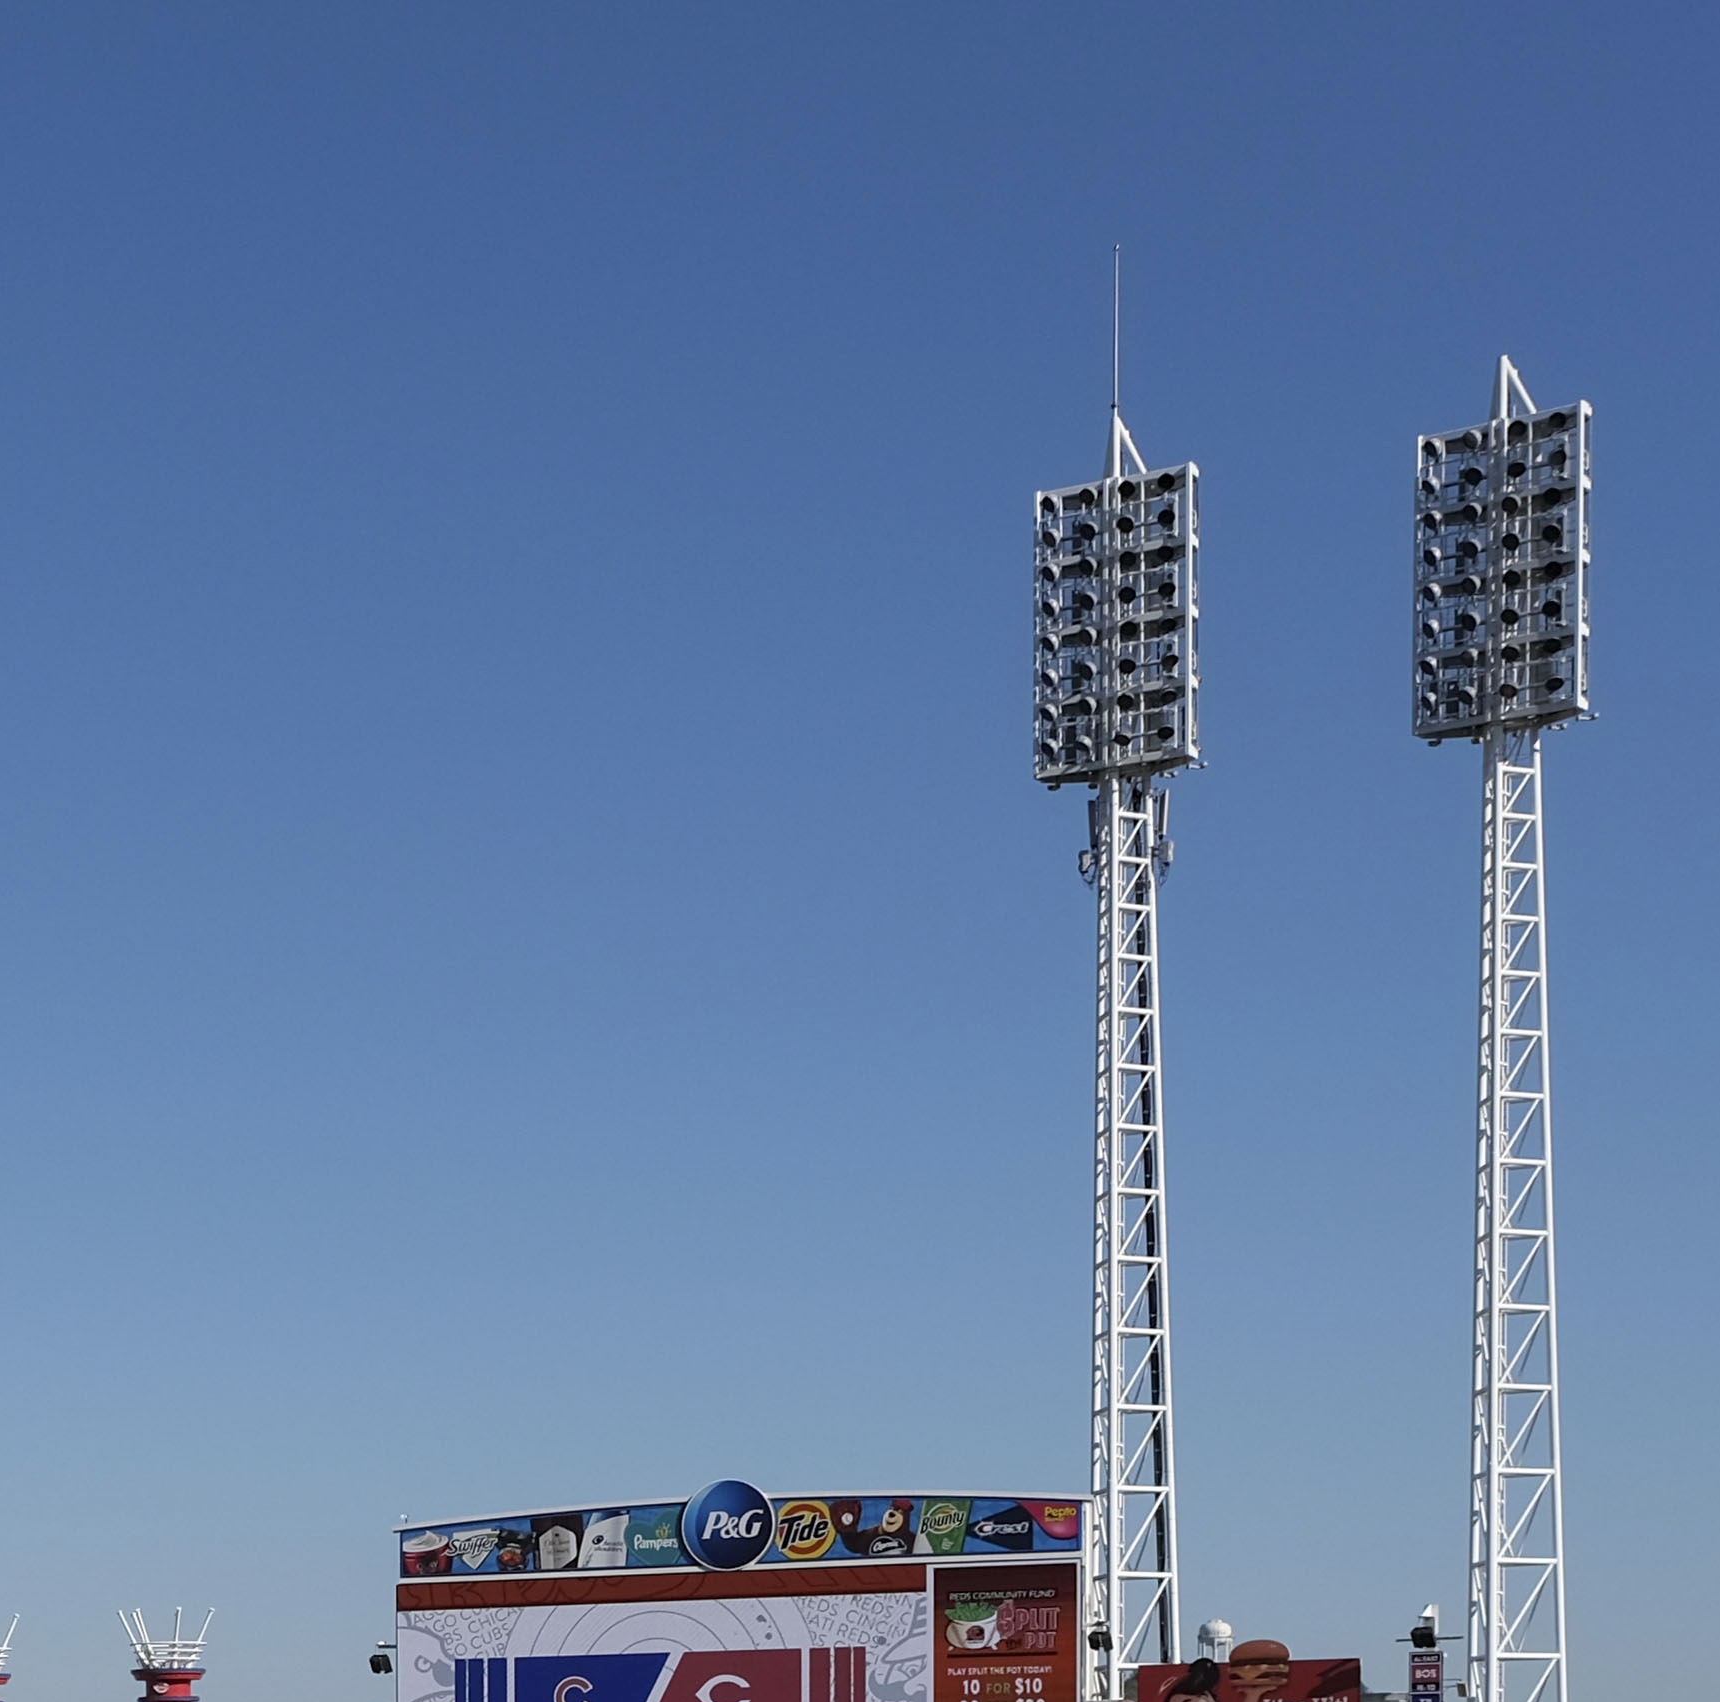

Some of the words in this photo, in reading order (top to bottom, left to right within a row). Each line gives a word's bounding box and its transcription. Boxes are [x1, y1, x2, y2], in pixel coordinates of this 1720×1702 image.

[920, 1503, 965, 1535] Bounty
[1044, 1506, 1077, 1517] Pepto
[702, 1509, 765, 1541] P&G
[778, 1515, 829, 1551] Tide
[976, 1520, 1029, 1536] Crest
[446, 1533, 499, 1557] Swiffer
[633, 1534, 678, 1551] Pampers
[1415, 1669, 1437, 1678] BOS
[963, 1679, 980, 1695] 10
[986, 1683, 1011, 1694] FOR
[1014, 1678, 1043, 1695] $10
